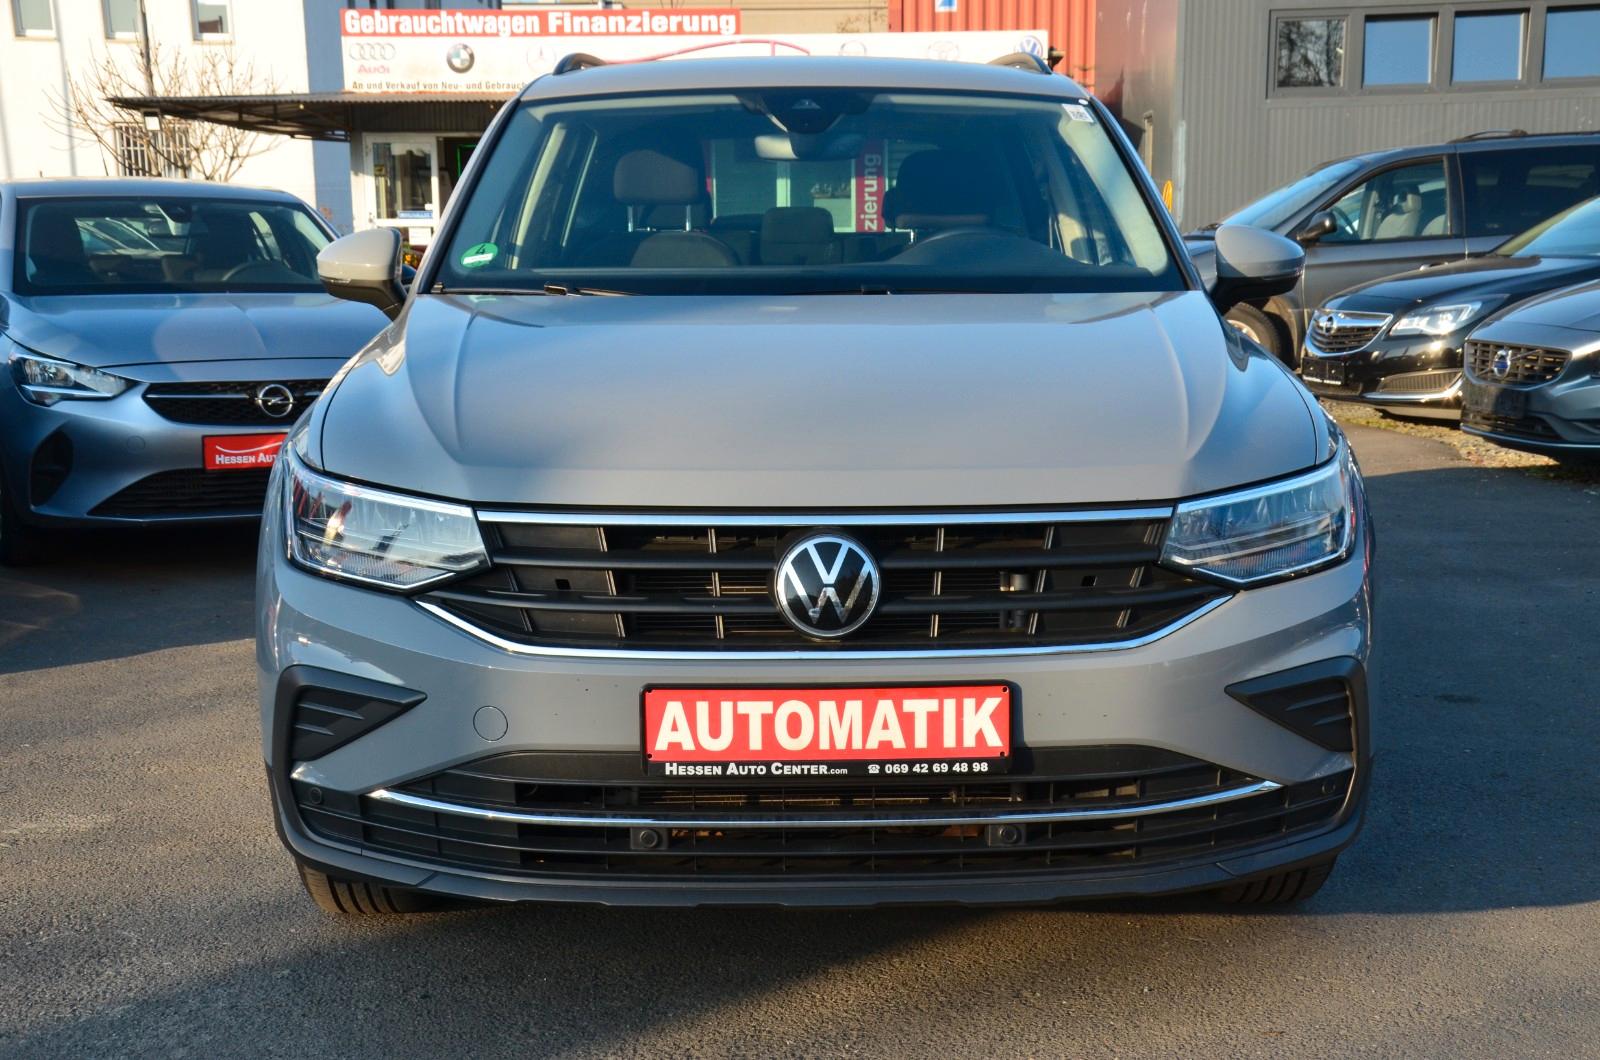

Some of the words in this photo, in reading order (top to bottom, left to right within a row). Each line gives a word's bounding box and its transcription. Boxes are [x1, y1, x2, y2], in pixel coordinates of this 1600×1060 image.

[344, 10, 540, 37] Gebrauchtwagen
[548, 11, 737, 35] Finanzierung
[352, 81, 364, 89] An
[366, 81, 383, 89] und
[385, 81, 420, 89] Verkauf
[441, 81, 463, 89] Neu-
[466, 81, 482, 89] und
[860, 154, 881, 231] zierung
[215, 454, 256, 464] HESSEN
[257, 452, 278, 463] AUT
[654, 697, 1003, 751] AUTOMATIK
[665, 762, 722, 775] HESSEN
[726, 762, 767, 775] AUTO
[884, 763, 909, 774] 069
[912, 763, 929, 773] 42
[932, 763, 949, 773] 69
[952, 762, 969, 773] 48
[972, 762, 989, 772] 98
